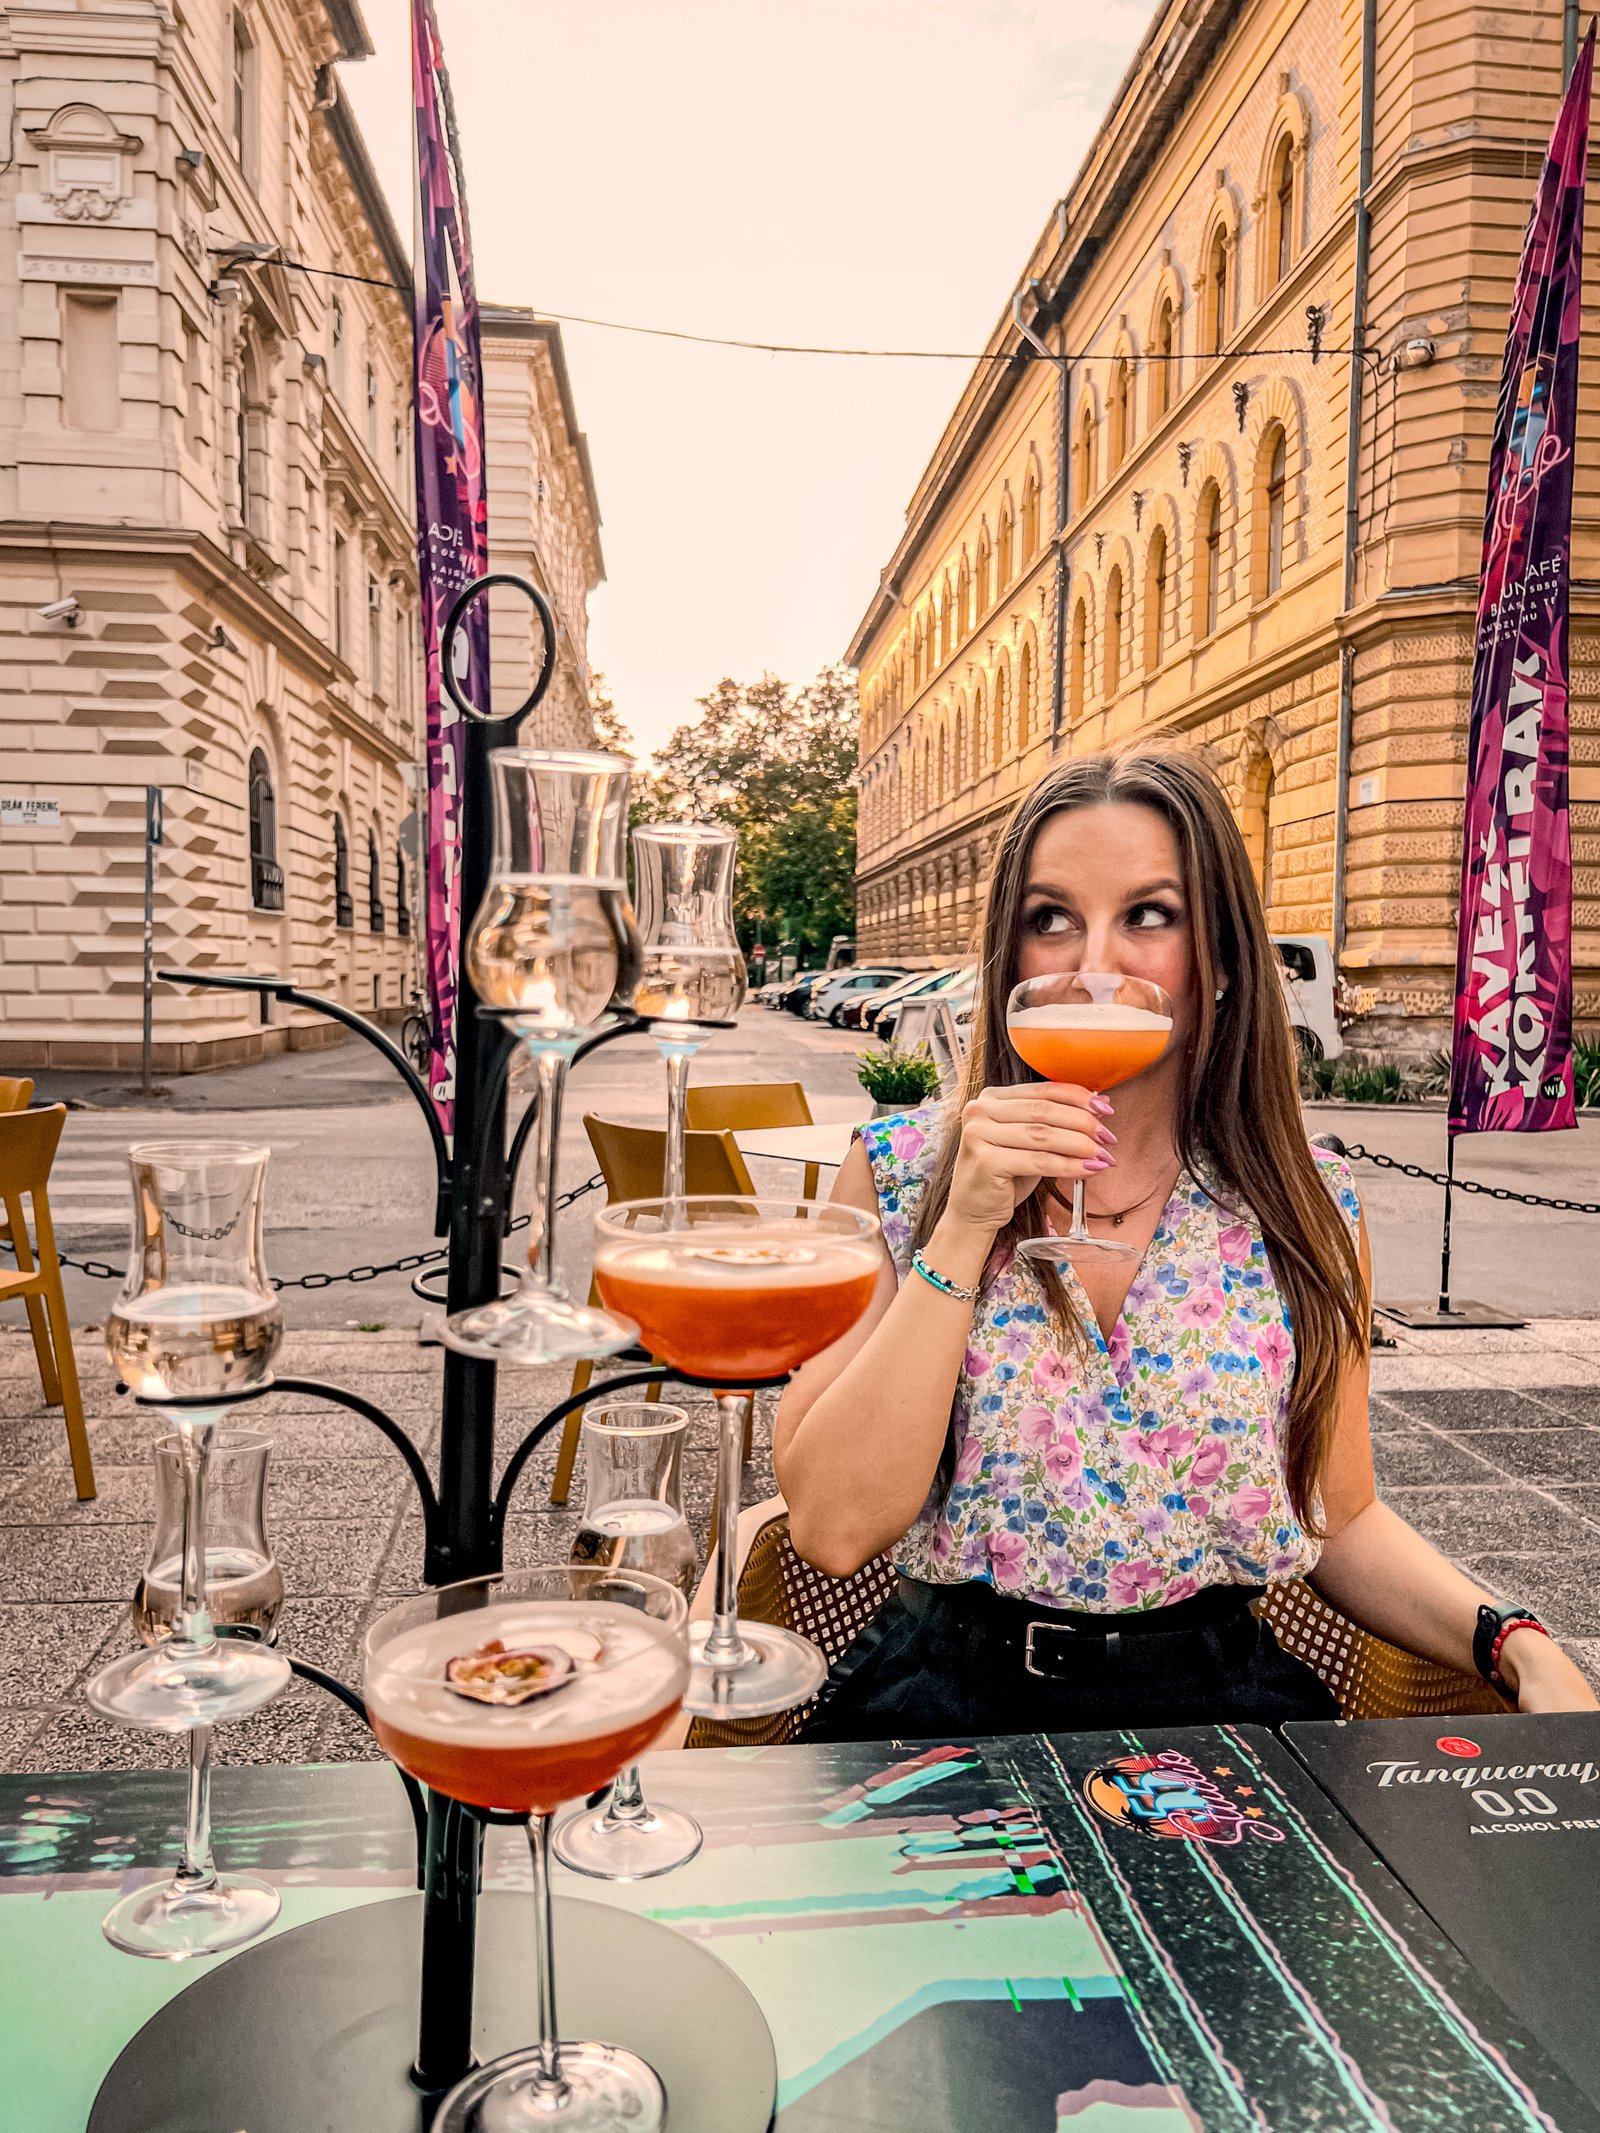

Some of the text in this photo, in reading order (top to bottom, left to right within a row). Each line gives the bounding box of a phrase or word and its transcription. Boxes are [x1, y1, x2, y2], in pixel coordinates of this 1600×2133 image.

[1366, 1760, 1600, 1789] Tanqueray
[1471, 1787, 1558, 1817] 0.0
[1469, 1819, 1600, 1835] ALCOHOL FRE
